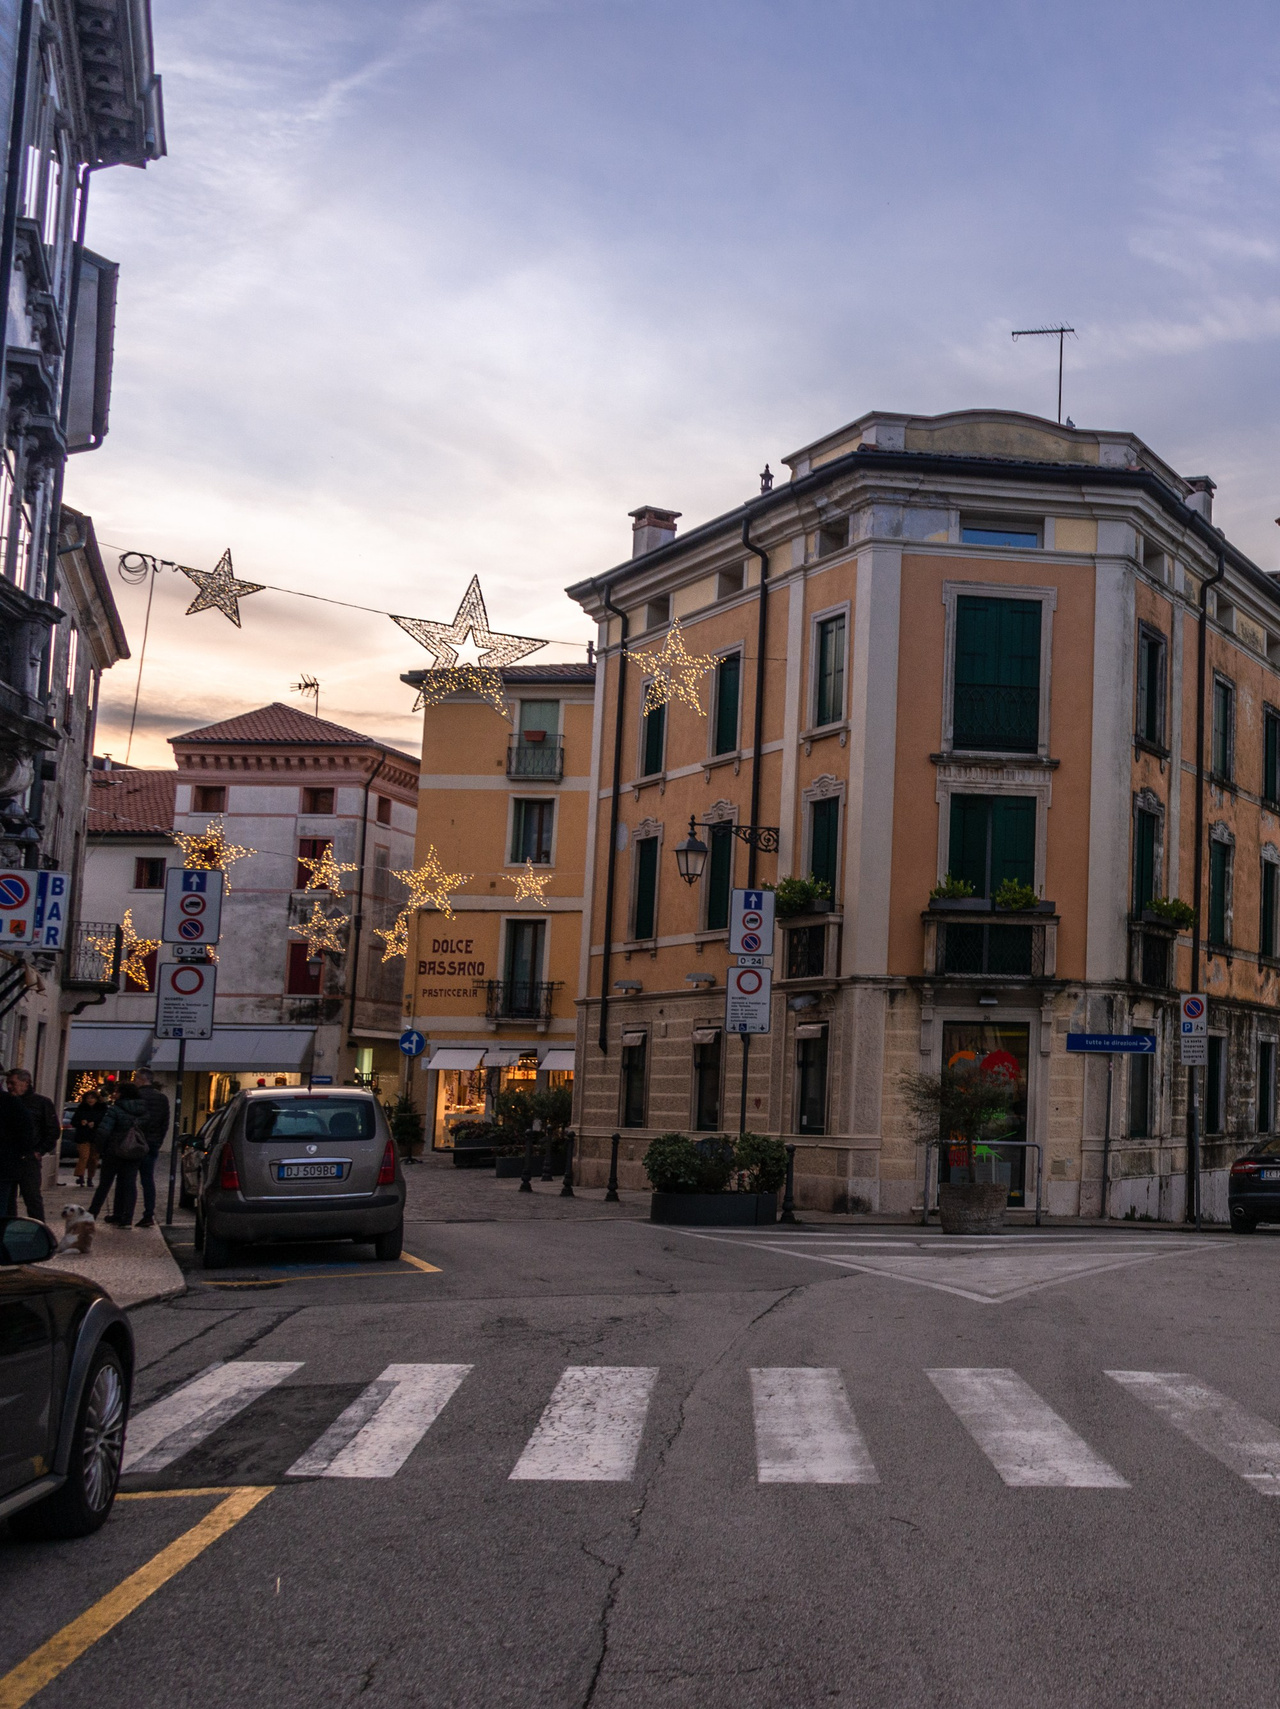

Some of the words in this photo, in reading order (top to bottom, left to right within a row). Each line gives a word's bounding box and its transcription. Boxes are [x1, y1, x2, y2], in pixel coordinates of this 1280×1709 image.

[45, 877, 64, 946] BAR
[432, 939, 473, 954] DOLCE
[418, 960, 485, 976] BASSANO
[422, 988, 478, 997] PASTICCERIA
[1184, 1023, 1191, 1031] P
[286, 1166, 300, 1177] DJ
[303, 1165, 336, 1177] 509BC
